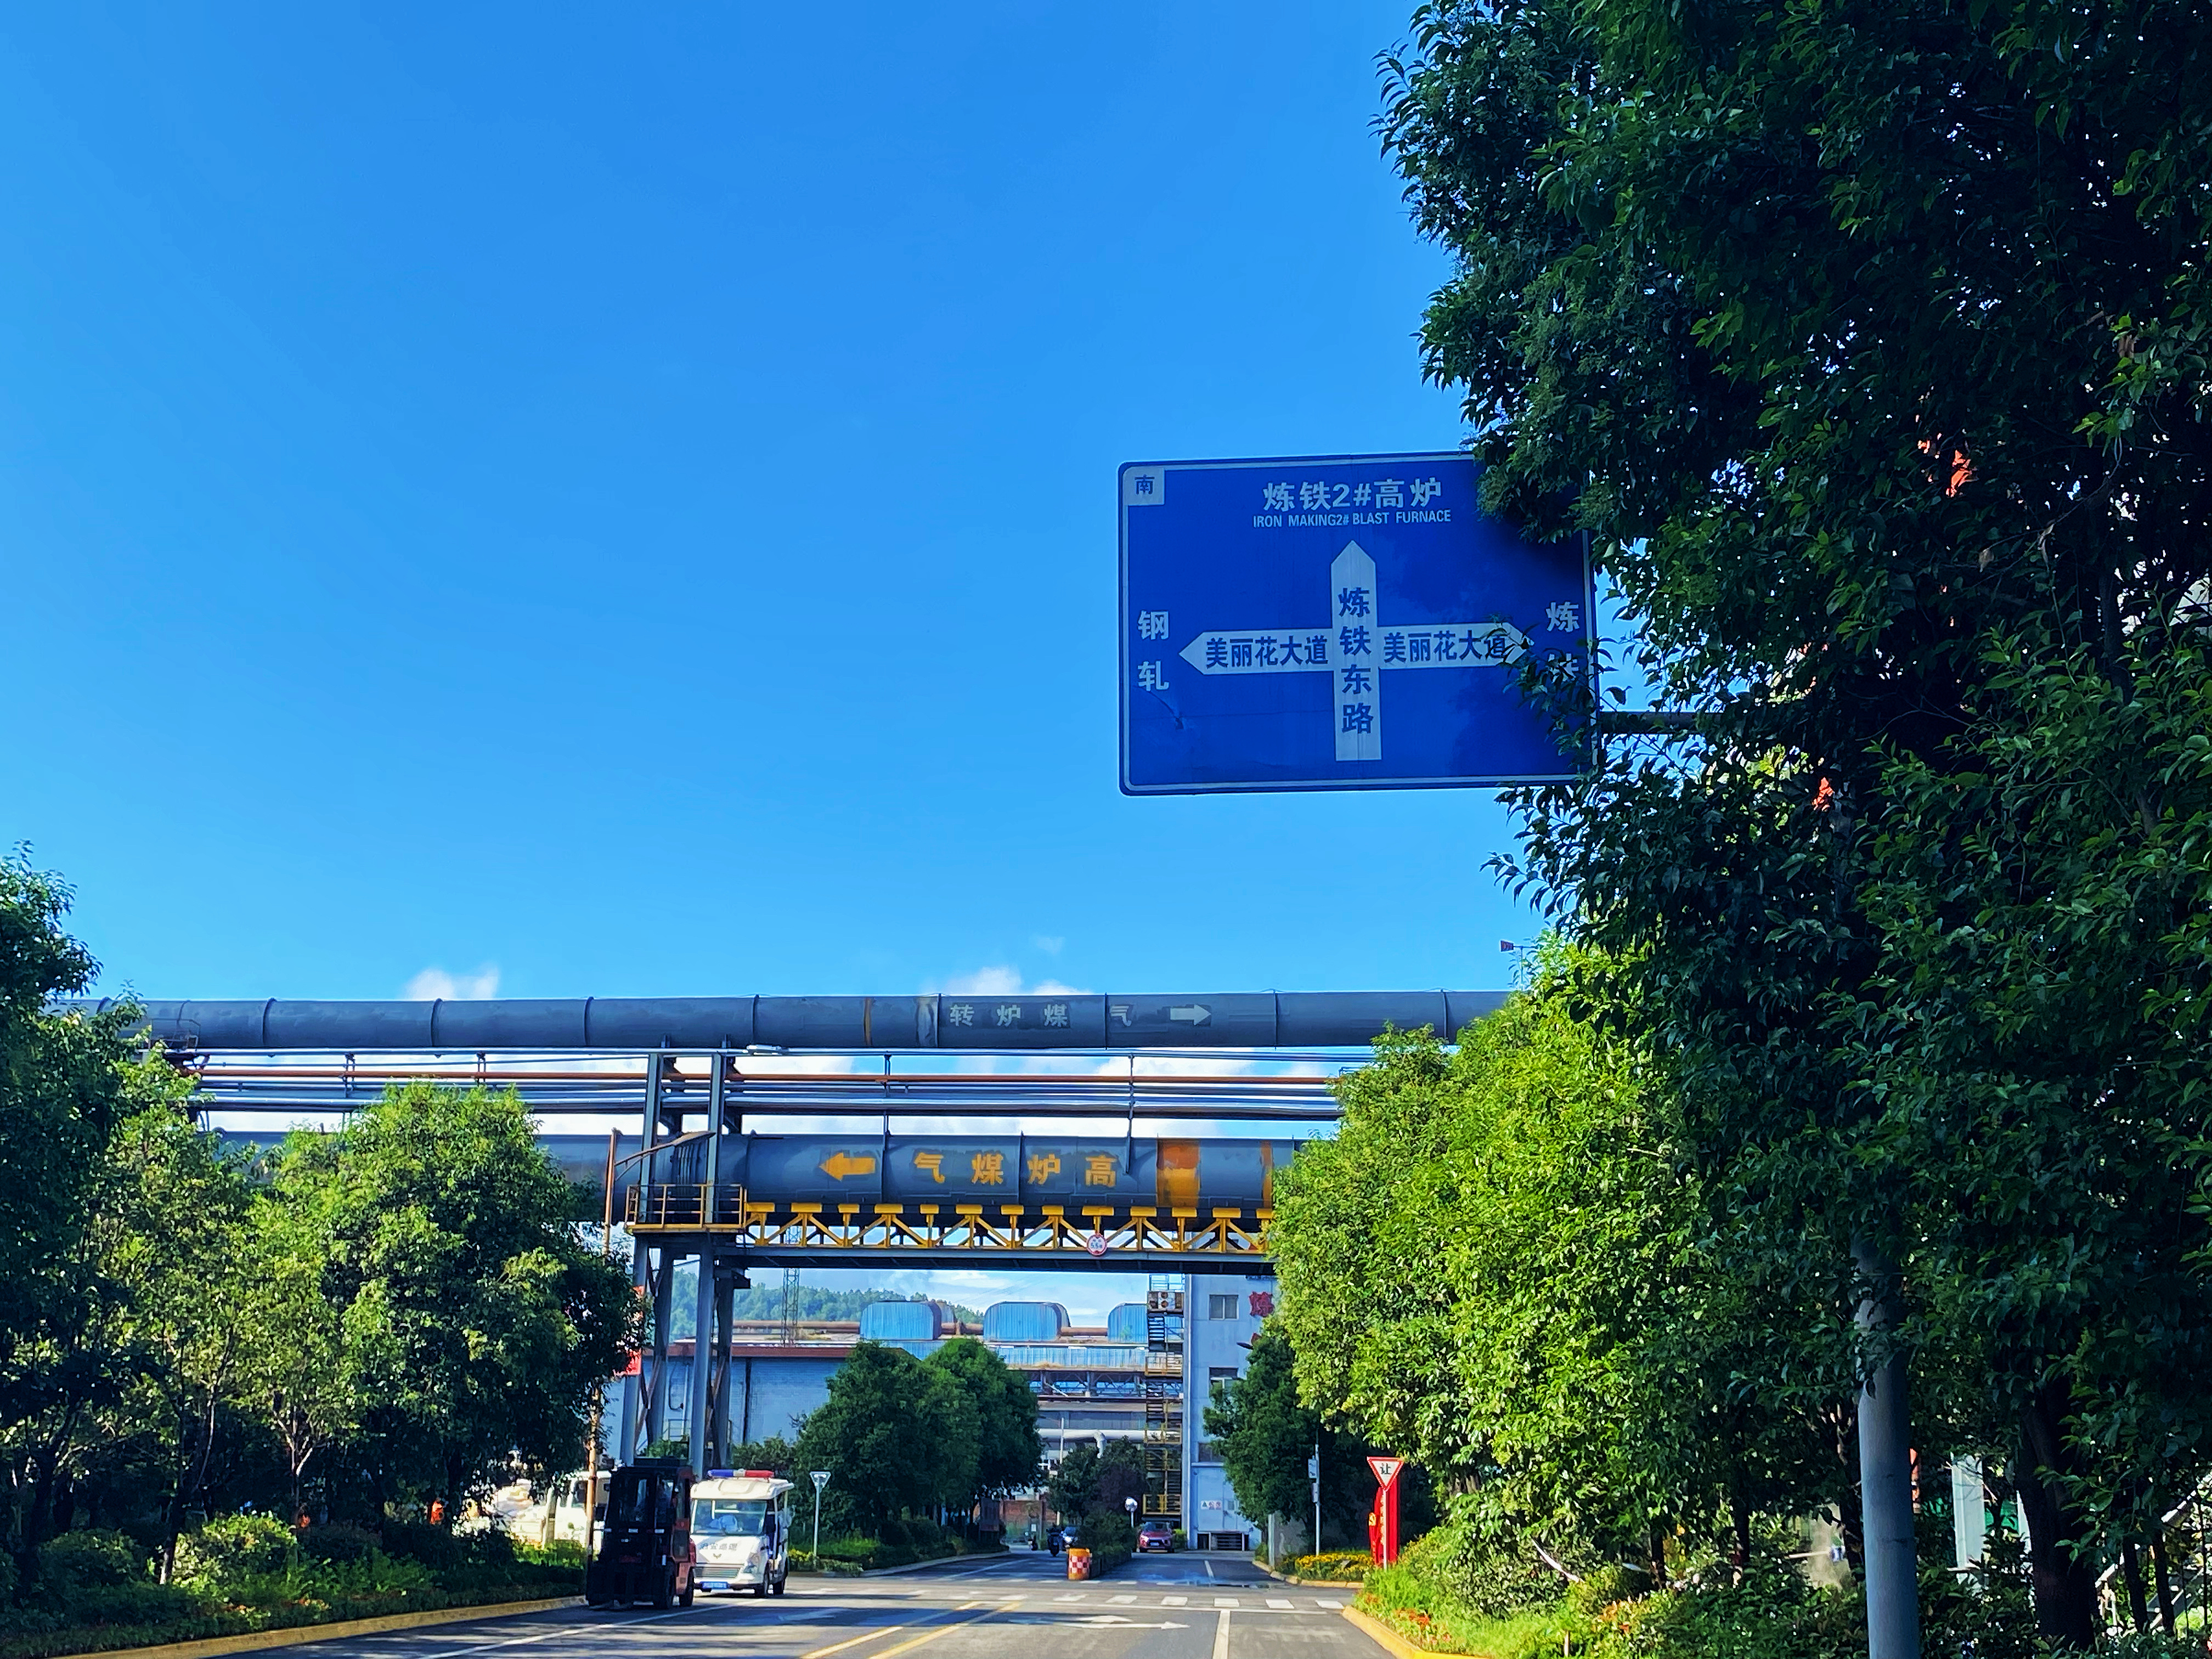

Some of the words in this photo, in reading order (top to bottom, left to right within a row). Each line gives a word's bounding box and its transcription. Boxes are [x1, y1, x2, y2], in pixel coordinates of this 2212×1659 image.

[1135, 473, 1155, 494] 南
[1263, 477, 1442, 512] 炼铁2#高炉
[1253, 515, 1282, 528] IRON
[1288, 514, 1350, 527] MAKING2#
[1352, 511, 1390, 525] BLAST
[1395, 509, 1451, 524] FURNACE
[1205, 635, 1329, 669] 美丽花大道
[1338, 586, 1374, 734] 炼铁东路
[1383, 629, 1508, 663] 美丽花大道
[949, 1003, 1133, 1028] 转炉煤气
[1379, 1462, 1392, 1475] 让
